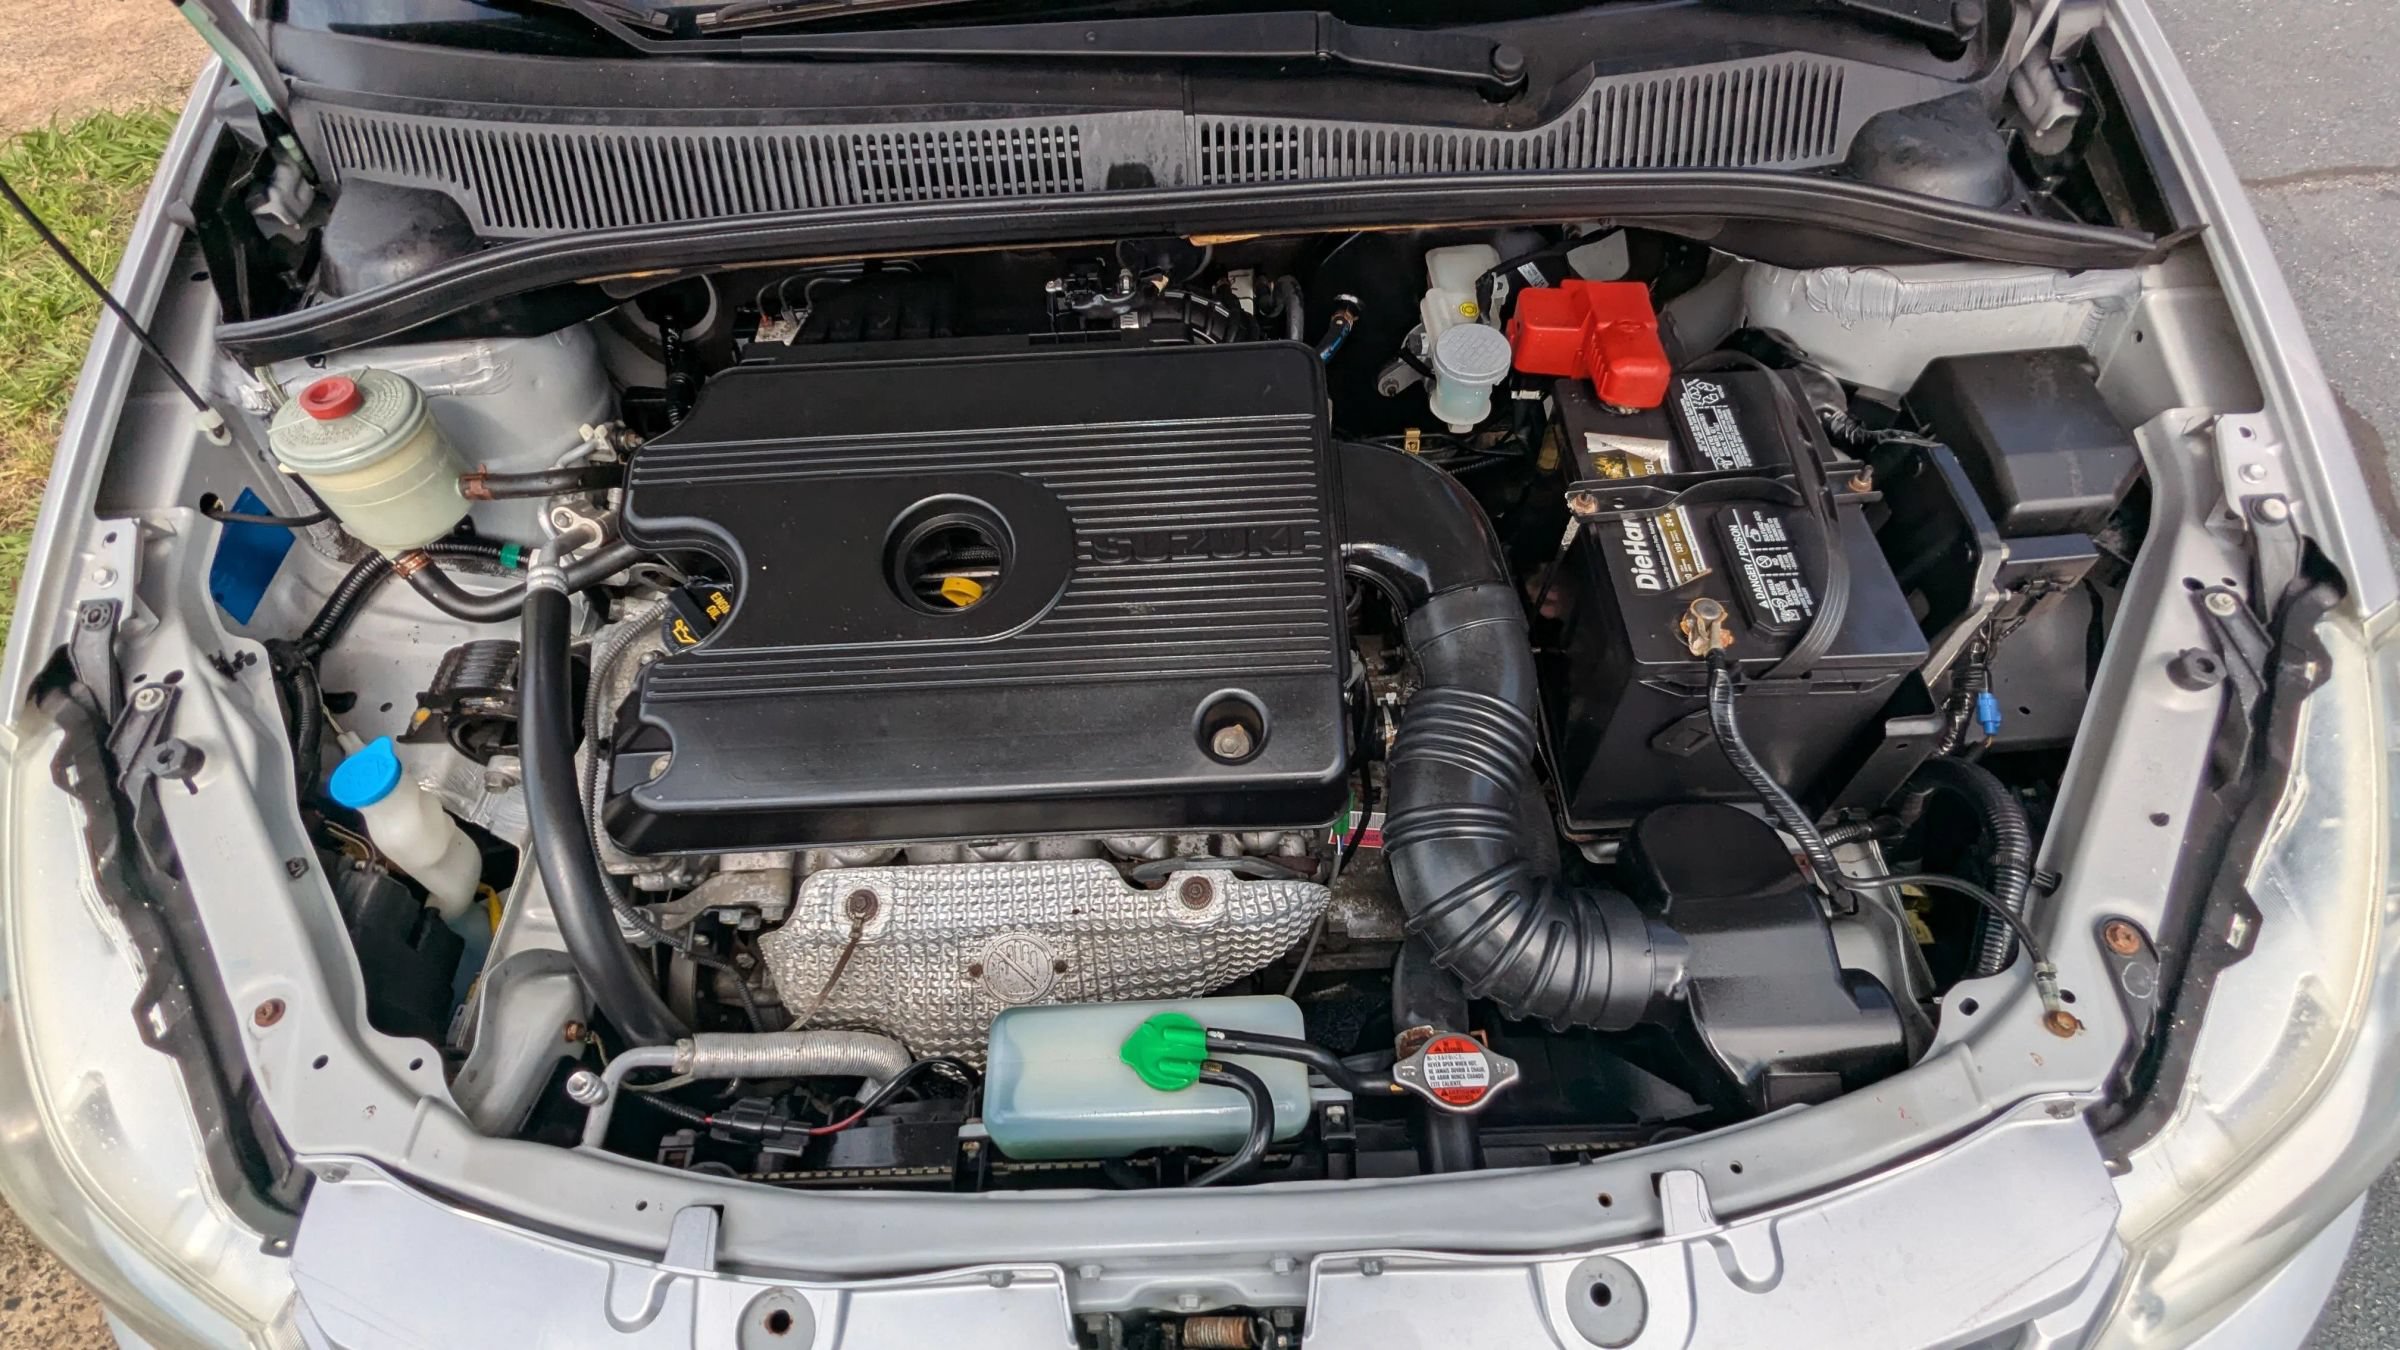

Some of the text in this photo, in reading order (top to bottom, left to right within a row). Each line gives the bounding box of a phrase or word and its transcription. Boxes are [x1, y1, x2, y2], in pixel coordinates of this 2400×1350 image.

[1644, 457, 1657, 475] GOL
[1093, 526, 1304, 564] SUZUKI
[1623, 516, 1660, 591] DieHar
[1728, 524, 1748, 555] POISON
[1743, 563, 1765, 598] DANGER
[706, 604, 721, 622] OIL
